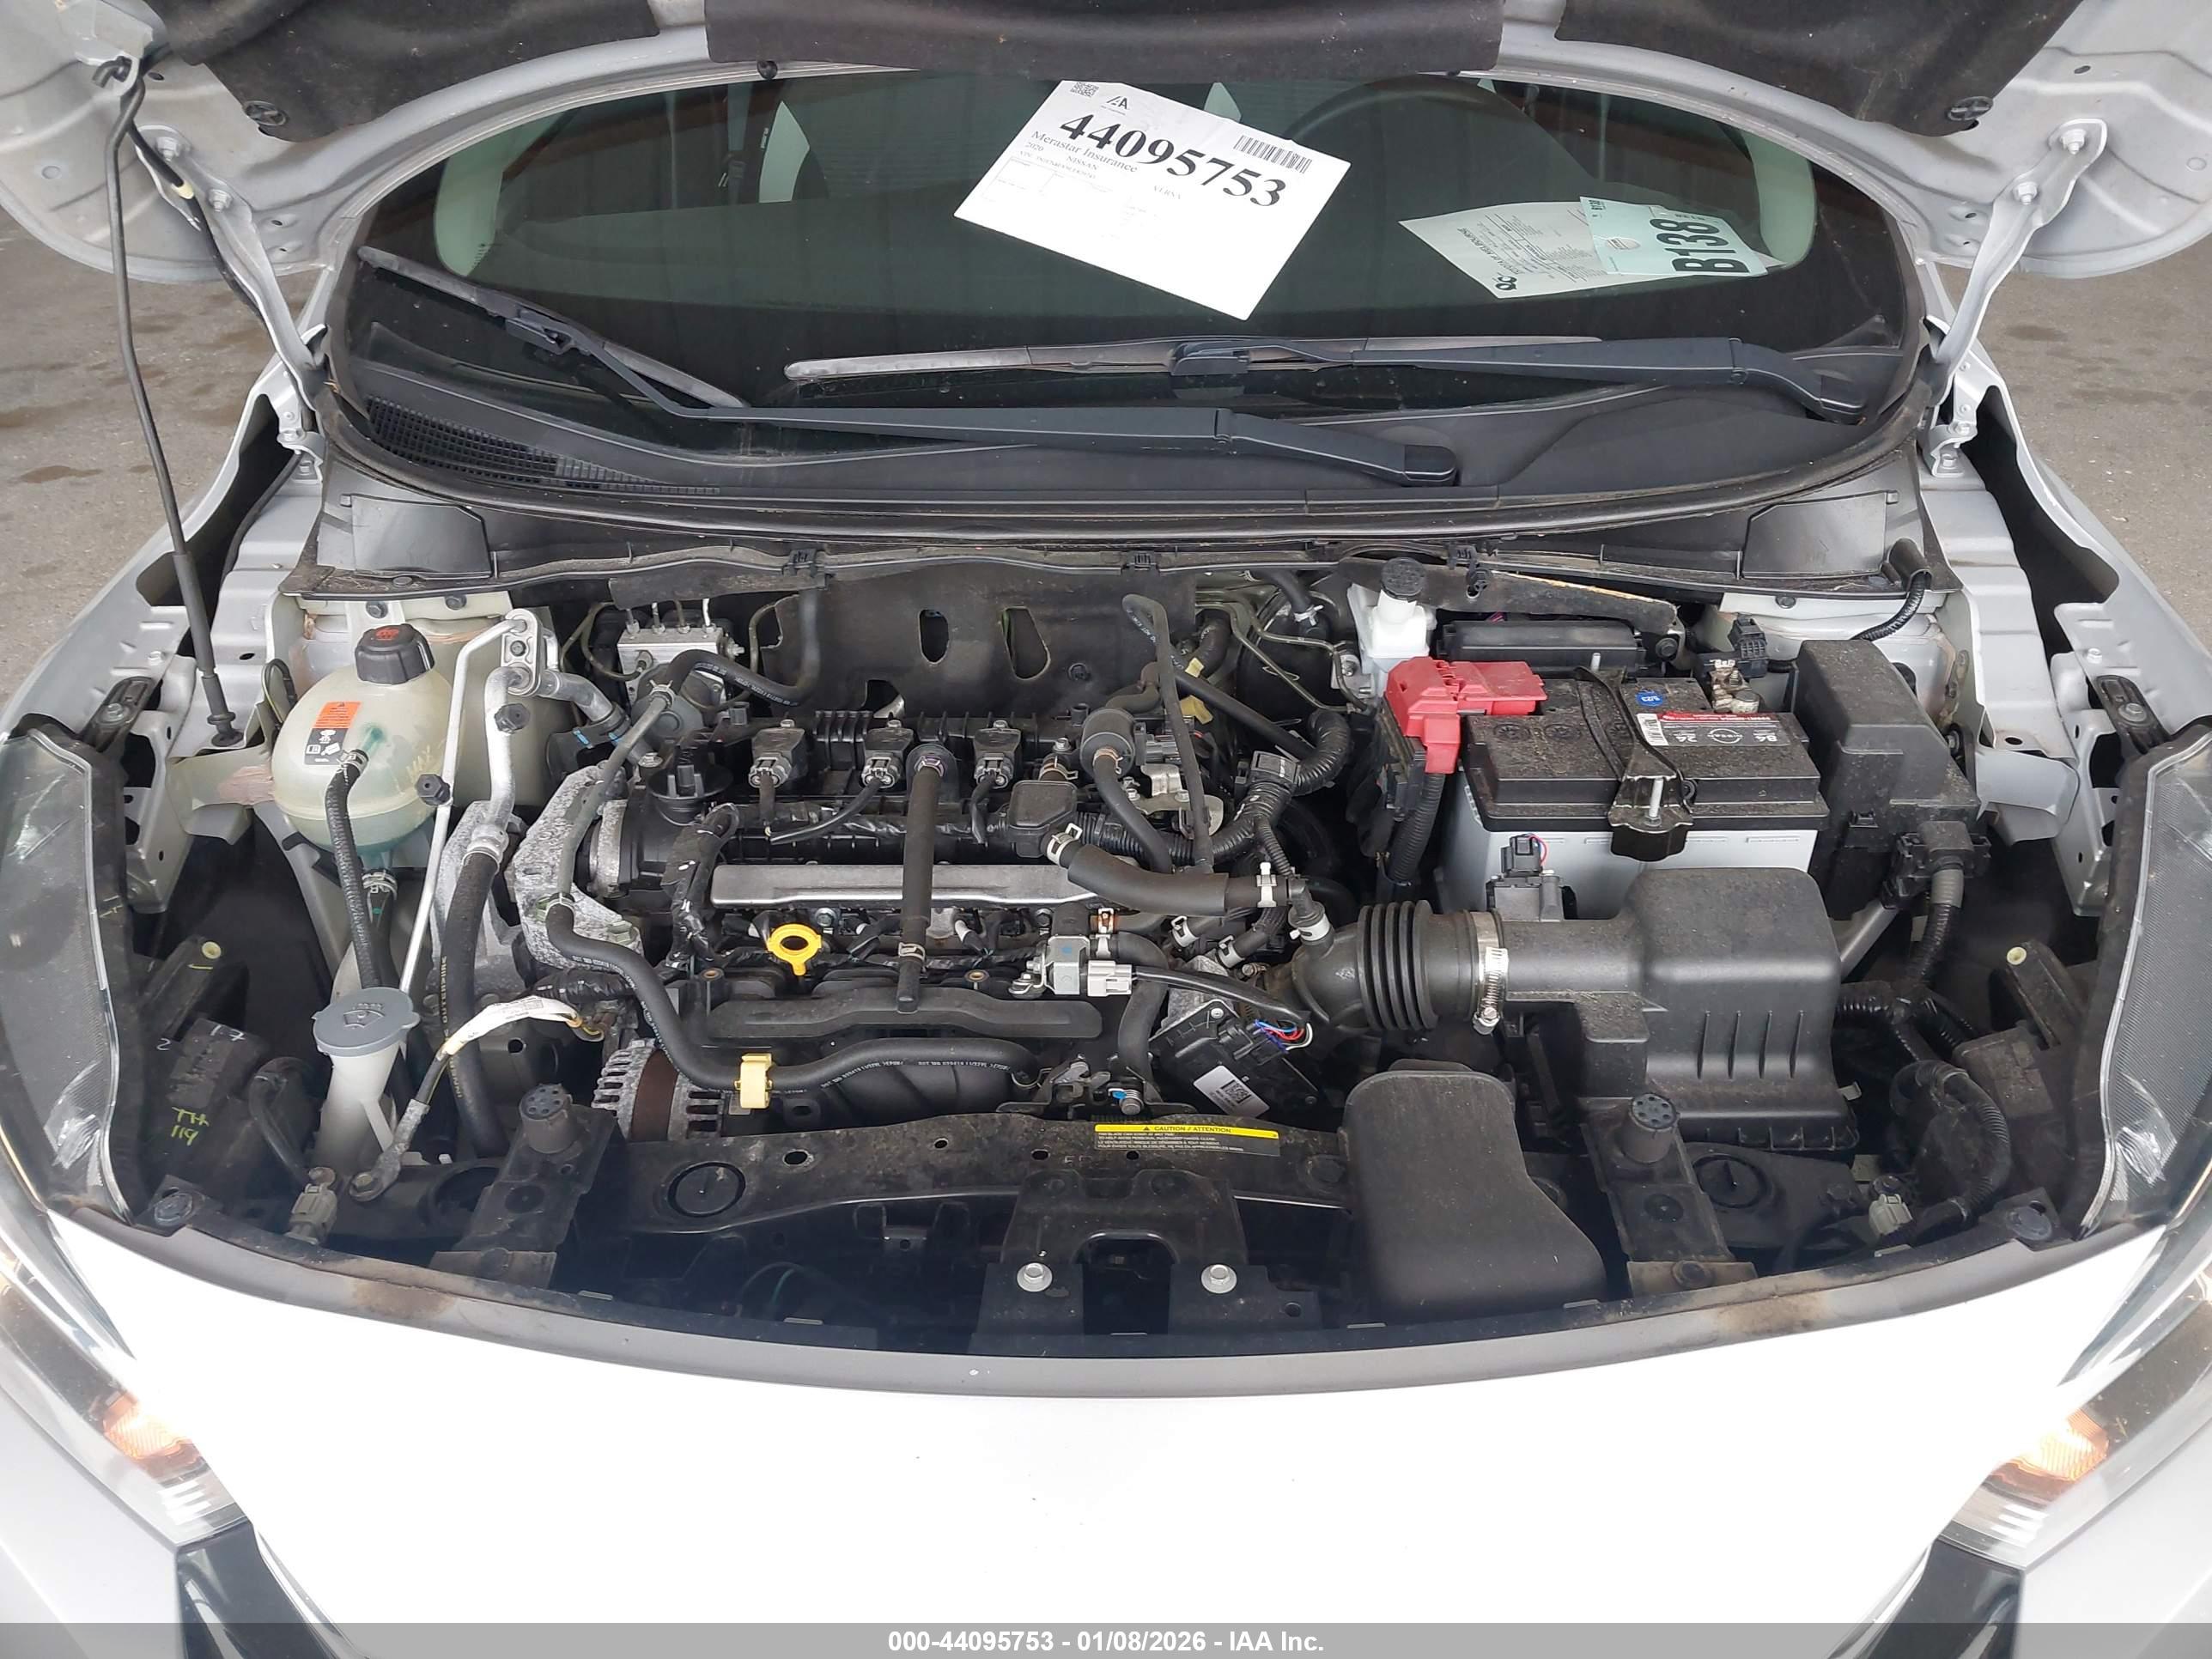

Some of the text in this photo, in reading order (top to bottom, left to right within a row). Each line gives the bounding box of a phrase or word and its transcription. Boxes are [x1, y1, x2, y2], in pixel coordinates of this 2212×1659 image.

[1031, 131, 1083, 154] Merastar
[1084, 148, 1138, 173] Insurance
[1060, 114, 1286, 207] 44095753
[1649, 218, 1750, 273] B138
